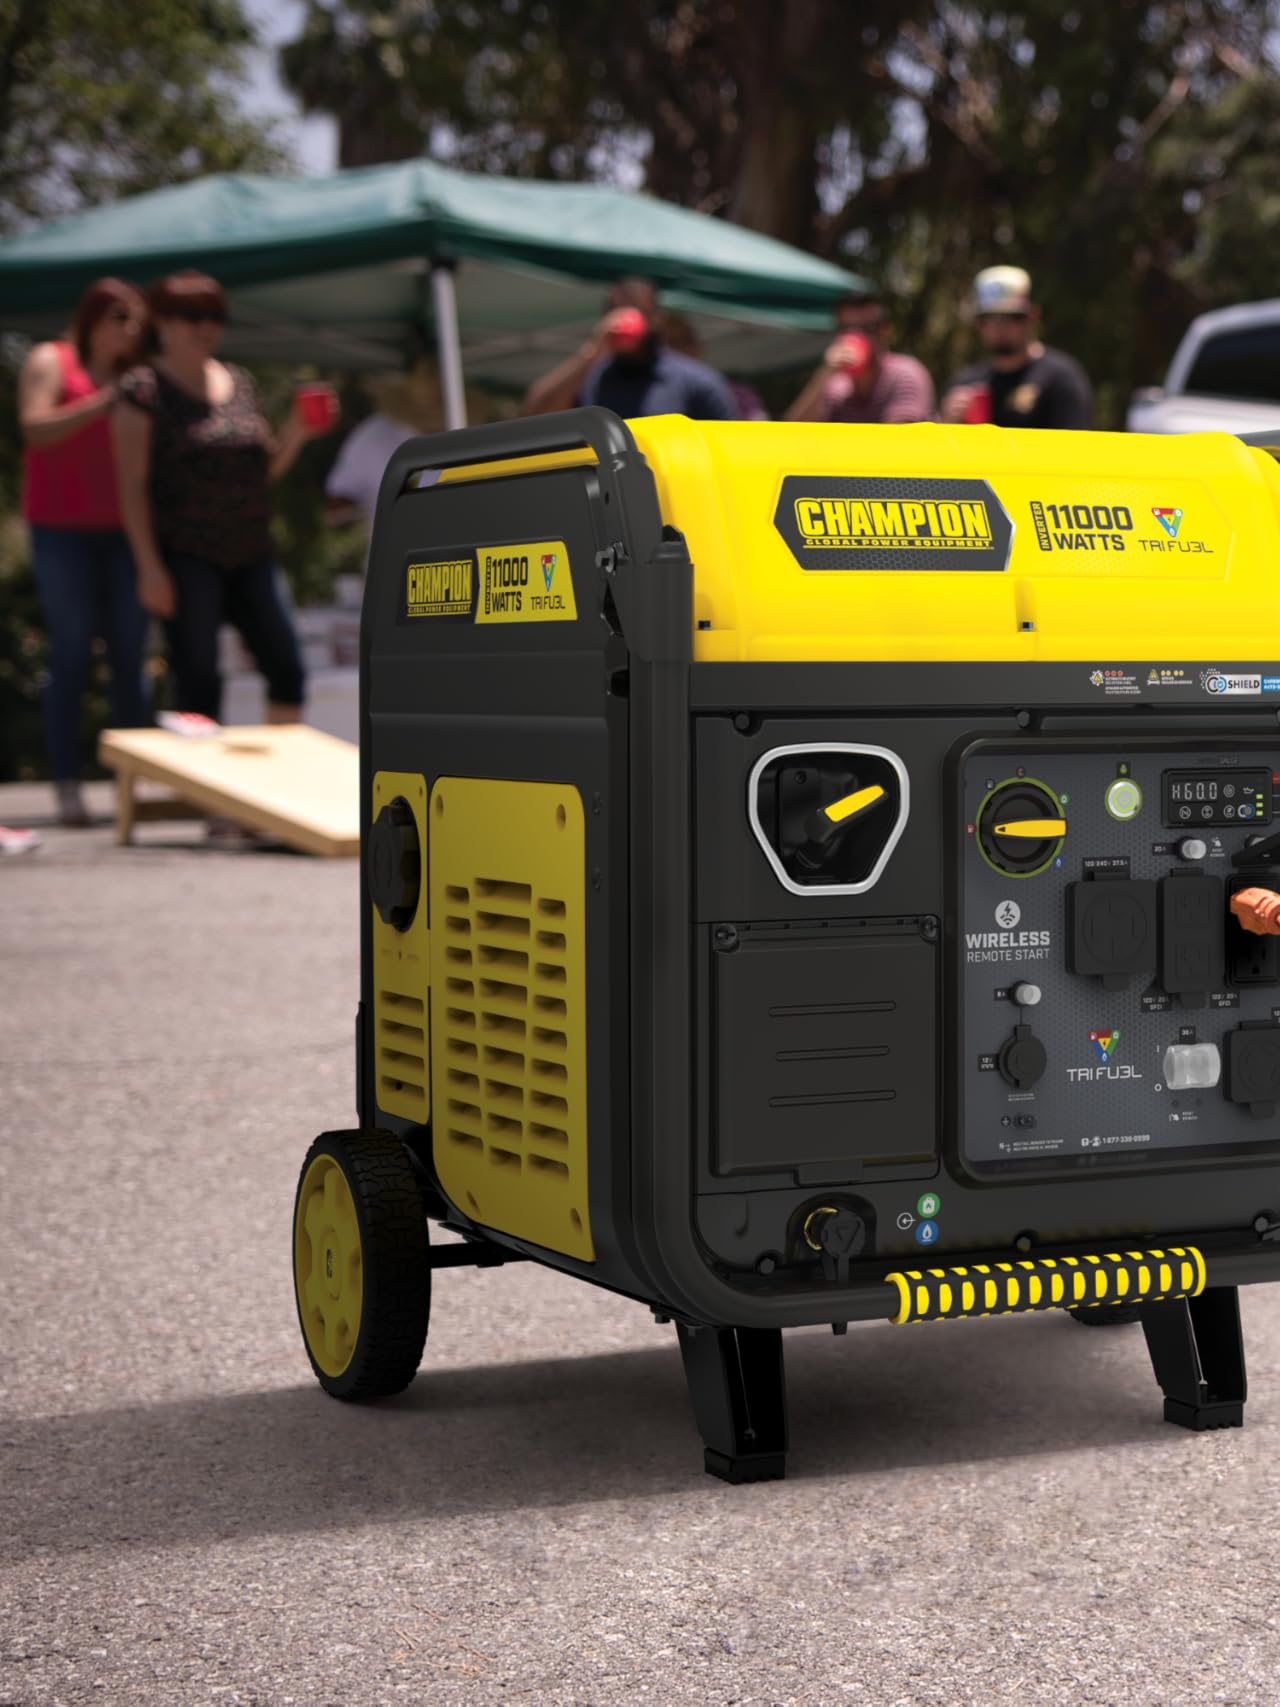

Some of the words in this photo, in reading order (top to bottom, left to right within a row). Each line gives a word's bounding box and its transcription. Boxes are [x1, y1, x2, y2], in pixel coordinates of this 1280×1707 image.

[796, 499, 990, 539] CHAMPION
[1032, 501, 1051, 550] INVERTER
[1046, 504, 1134, 531] 11000
[806, 538, 858, 546] GLOBAL
[862, 539, 909, 547] POWER
[914, 539, 991, 548] EQUIPMENT
[1053, 533, 1126, 551] WATTS
[408, 561, 472, 605] CHAMPION
[492, 556, 528, 588] 11000
[491, 590, 522, 612] WATTS
[1228, 679, 1260, 689] SHIELD
[965, 930, 1051, 949] WIRELESS
[967, 950, 1013, 962] REMOTE
[1015, 948, 1050, 960] START
